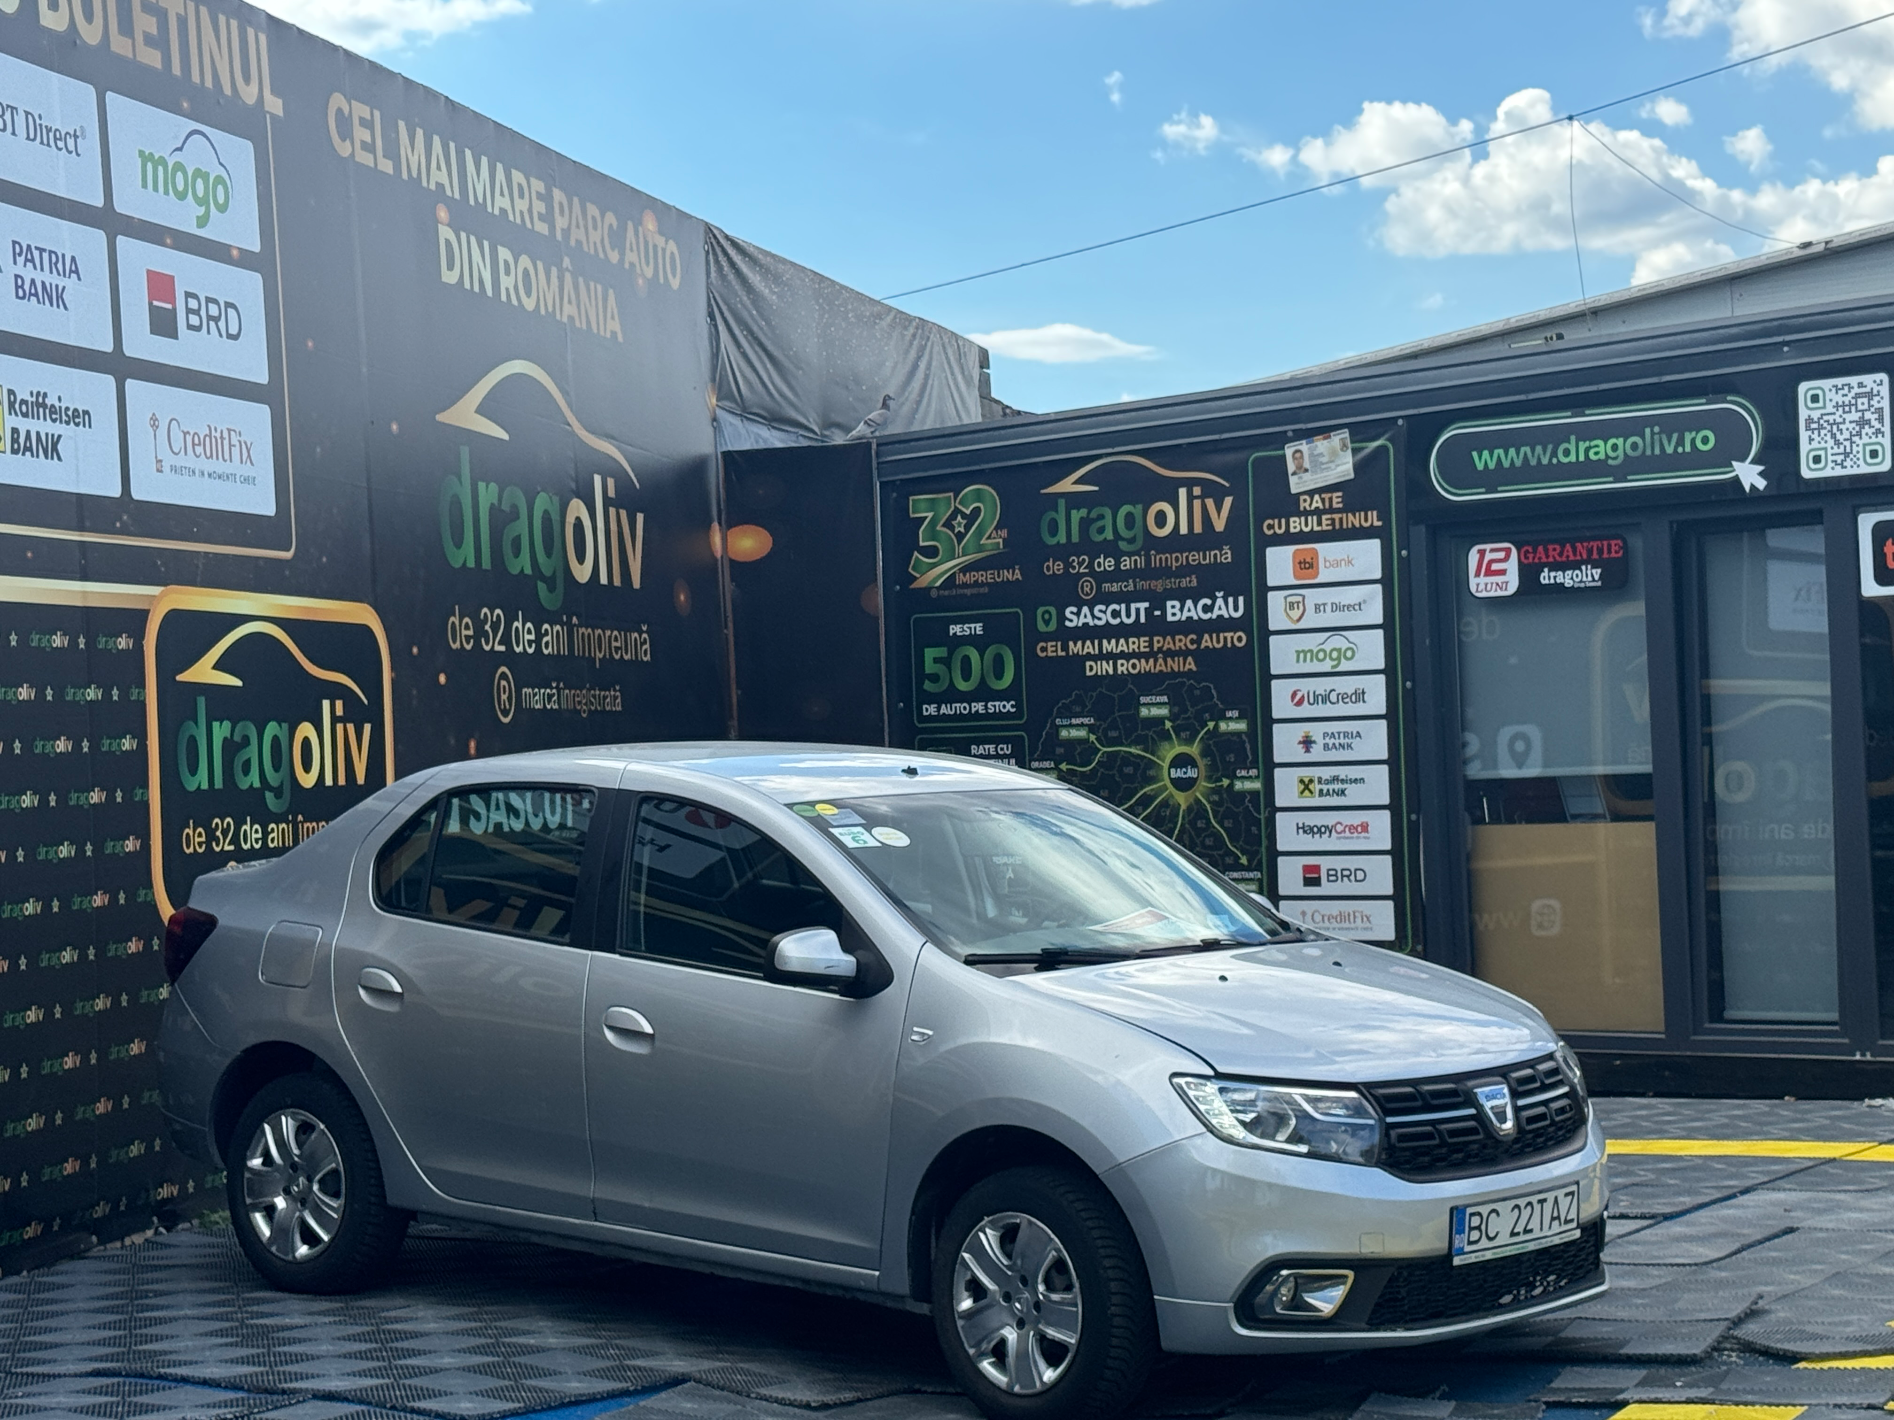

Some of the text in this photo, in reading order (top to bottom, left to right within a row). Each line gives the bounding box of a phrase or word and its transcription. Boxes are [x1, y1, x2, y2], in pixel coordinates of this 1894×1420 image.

[138, 148, 231, 229] mogo
[327, 92, 681, 291] CEL MAI MARE PARC AUTO
[11, 239, 82, 282] PATRIA
[14, 273, 69, 312] BANK
[437, 222, 624, 343] DIN ROMÂNIA
[184, 290, 243, 342] BRD
[6, 387, 92, 430] Raiffeisen
[10, 427, 64, 462] BANK
[167, 417, 255, 467] CreditFix
[1472, 425, 1716, 472] www.dragoliv.ro
[1299, 492, 1343, 511] RATE
[440, 445, 645, 611] dragoliv
[1040, 487, 1234, 551] dragoliv
[1262, 511, 1383, 535] CU BULETINUL
[991, 529, 1007, 539] ANI
[1043, 545, 1233, 575] de 32 de ani împreună
[1323, 556, 1355, 569] bank
[1474, 546, 1512, 578] 12
[1520, 539, 1624, 564] GARANTIE
[955, 565, 1022, 585] ÎMPREUNĂ
[1297, 557, 1314, 571] tbi
[1101, 579, 1135, 593] marcă
[1136, 575, 1197, 593] înregistrată
[1540, 564, 1602, 587] dragoliv
[1475, 581, 1509, 593] LUNI
[1064, 602, 1149, 627] SASCUT
[1166, 592, 1245, 623] BACĂU
[1288, 601, 1301, 611] BT
[1314, 603, 1328, 614] BT
[29, 631, 69, 651] dragoliv
[447, 605, 651, 668] de 32 de ani împreună
[949, 623, 984, 637] PESTE
[97, 633, 133, 652] dragoliv
[1036, 631, 1247, 657] CEL MAI MARE PARC AUTO
[922, 644, 1015, 692] 500
[1085, 654, 1197, 677] DIN ROMÂNIA
[1294, 646, 1356, 670] mogo
[0, 683, 36, 704] ragoliv
[65, 684, 103, 704] dragoliv
[522, 681, 559, 710] marcă
[560, 681, 622, 718] înregistrată
[1306, 687, 1367, 706] UniCredit
[923, 701, 1016, 716] DE AUTO PE STOC
[34, 736, 73, 757] dragoliv
[101, 734, 137, 754] dragoliv
[1322, 730, 1362, 741] PATRIA
[176, 696, 372, 813] dragoliv
[971, 744, 1012, 756] RATE CU
[1322, 742, 1355, 752] BANK
[1170, 765, 1198, 778] BACĂU
[1317, 775, 1365, 786] Raiffeisen
[68, 787, 107, 808] dragoliv
[1318, 787, 1348, 798] BANK
[182, 819, 206, 854] de
[212, 817, 235, 852] 32
[240, 816, 263, 849] de
[268, 815, 293, 848] ani
[1296, 821, 1369, 839] HappyCredit
[36, 841, 76, 863] dragoliv
[104, 835, 141, 856] dragoliv
[1326, 868, 1367, 883] BRD
[1, 897, 42, 920] dragoliv
[71, 890, 109, 912] dragoliv
[1311, 909, 1372, 925] CreditFix
[39, 946, 78, 968] dragoliv
[107, 936, 144, 958] dragoliv
[73, 993, 112, 1016] dragoliv
[3, 1005, 44, 1029] dragoliv
[108, 1038, 146, 1061] dragoliv
[40, 1051, 81, 1075] dragoliv
[1466, 1207, 1500, 1246] BC
[1455, 1233, 1464, 1248] RO
